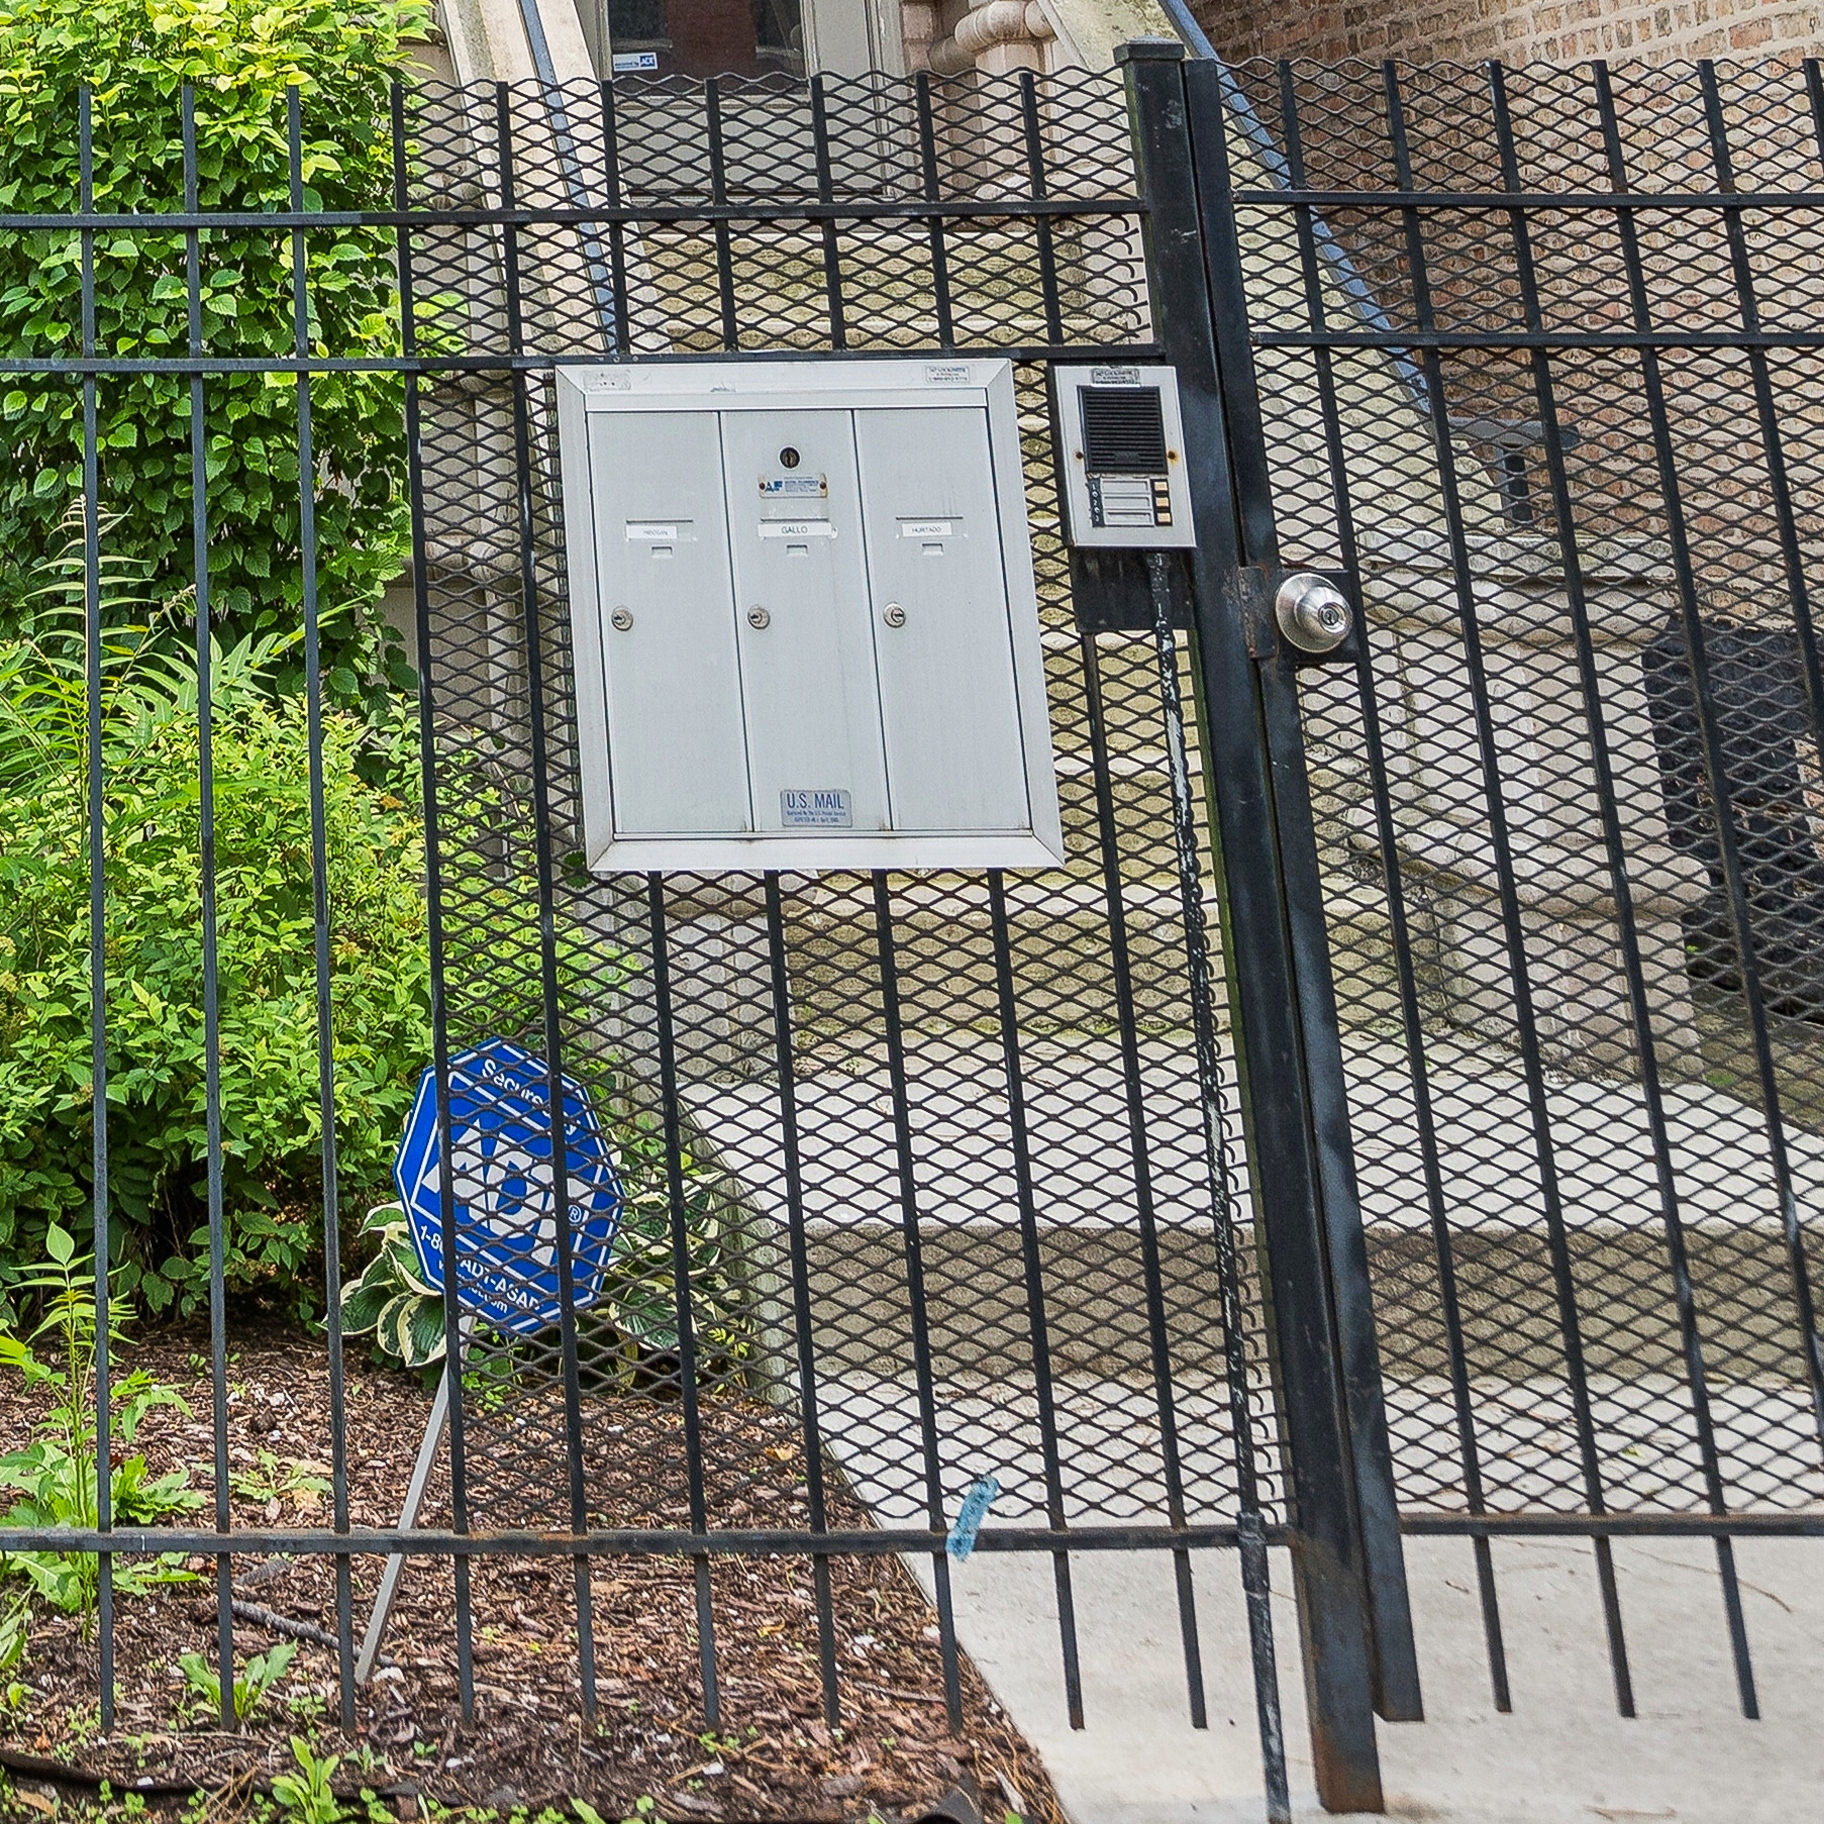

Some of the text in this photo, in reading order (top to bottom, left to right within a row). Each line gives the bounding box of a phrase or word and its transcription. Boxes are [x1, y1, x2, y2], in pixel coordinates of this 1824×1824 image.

[787, 792, 845, 809] U.S. MAIL
[482, 1059, 552, 1119] Secure
[421, 1118, 595, 1267] ADT
